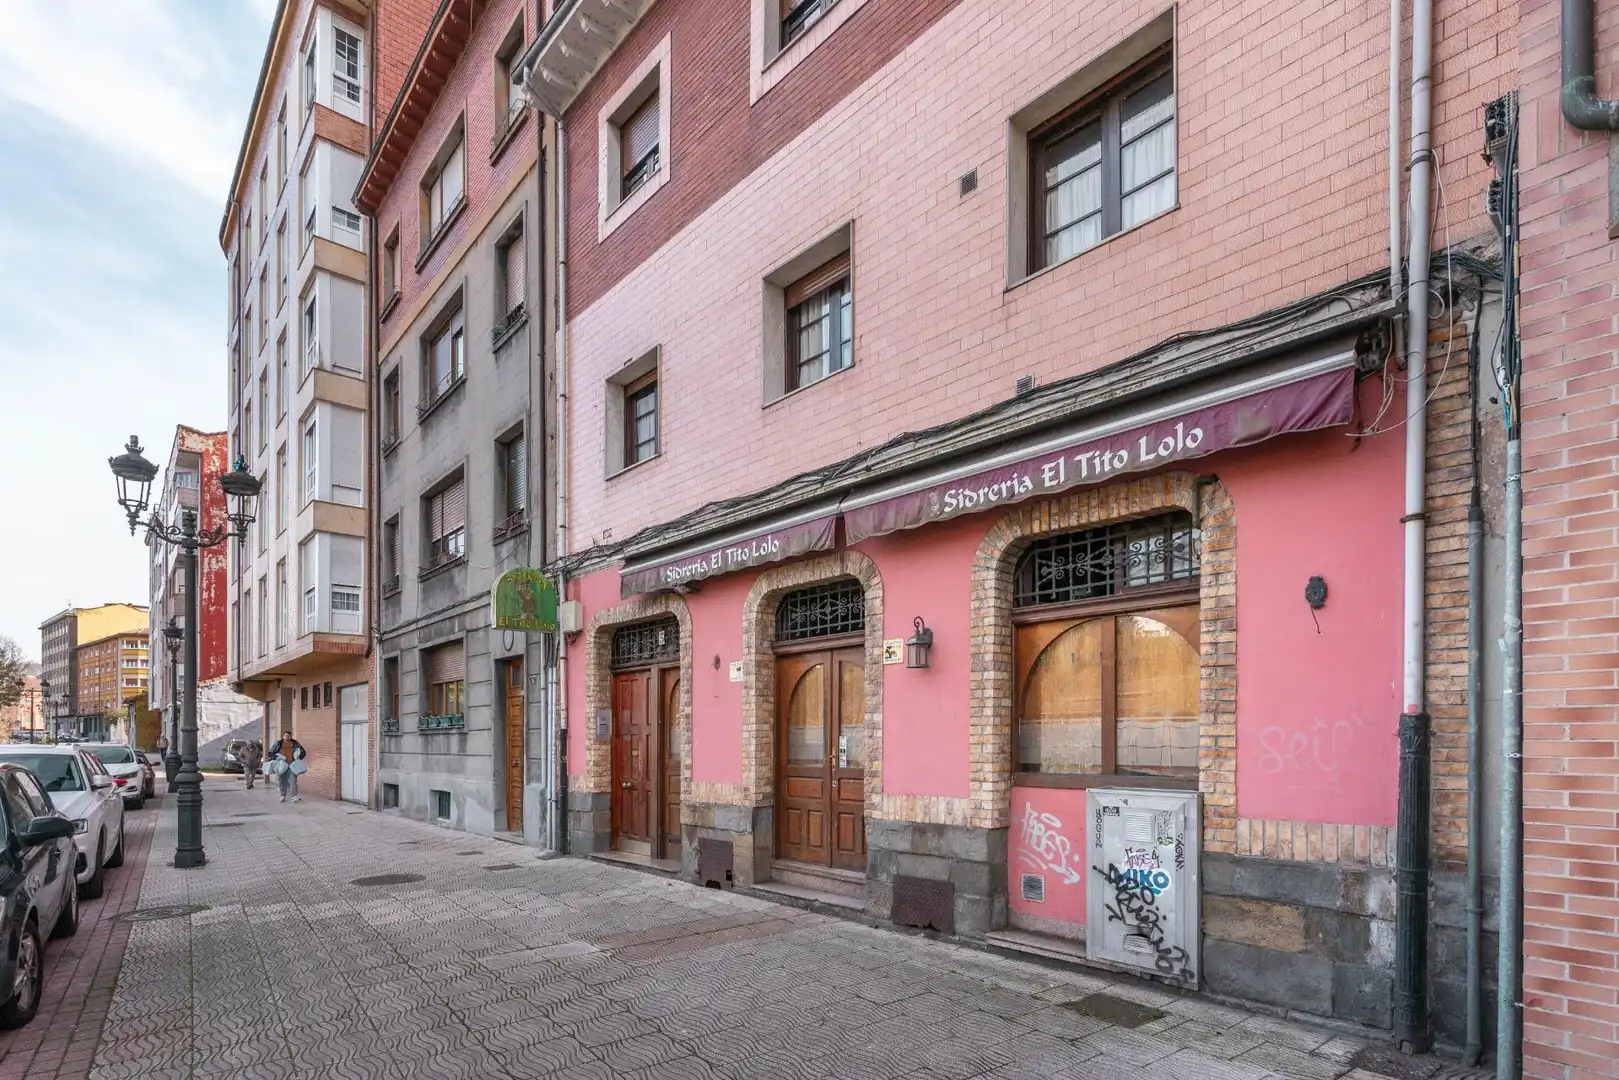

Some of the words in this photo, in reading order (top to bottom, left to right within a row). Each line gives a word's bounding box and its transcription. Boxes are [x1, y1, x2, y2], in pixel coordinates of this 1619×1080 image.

[1041, 456, 1064, 487] El
[1073, 449, 1129, 478] Tito
[1138, 421, 1204, 462] Lolo
[711, 550, 722, 569] El
[725, 547, 749, 565] Tito
[752, 535, 780, 557] Lolo
